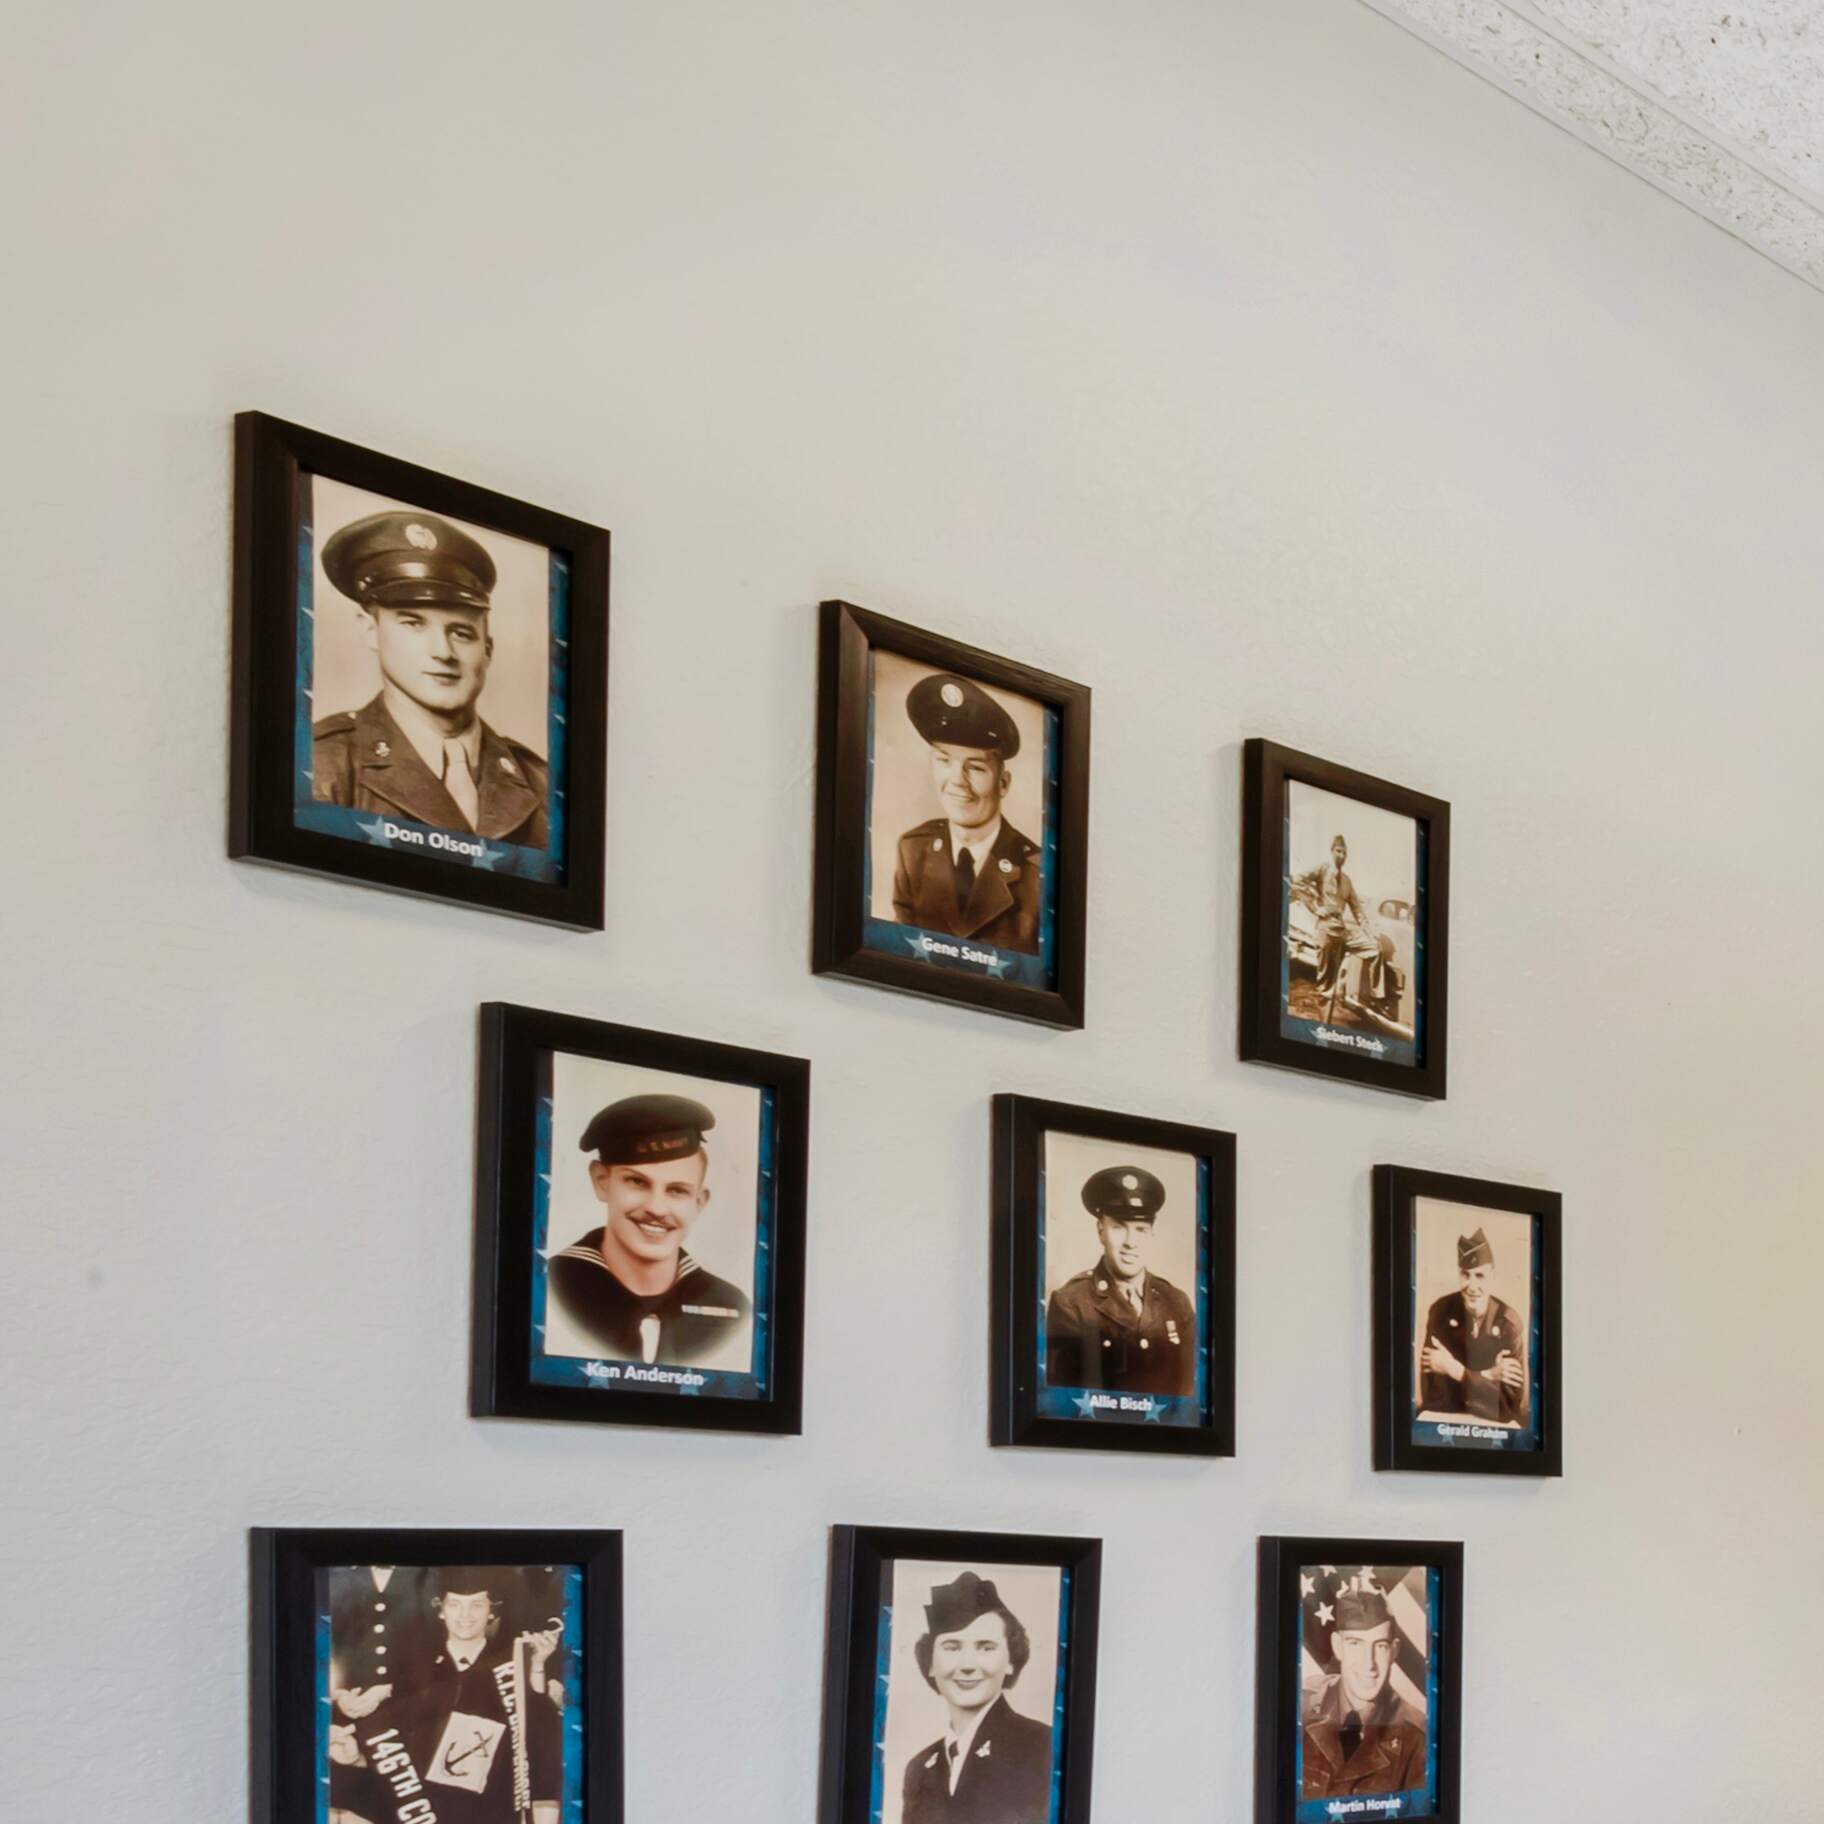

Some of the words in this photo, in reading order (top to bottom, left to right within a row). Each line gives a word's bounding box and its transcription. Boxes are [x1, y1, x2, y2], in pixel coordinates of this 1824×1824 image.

[384, 823, 423, 844] Don
[428, 833, 483, 856] Olson
[922, 938, 959, 958] Gene
[961, 946, 997, 966] Satre
[587, 1362, 620, 1378] Ken
[624, 1366, 704, 1386] Anderson
[1089, 1394, 1118, 1409] Allie
[1120, 1397, 1152, 1411] Bisch
[1437, 1424, 1470, 1437] Gerald
[366, 1728, 422, 1798] 146TH
[1328, 1800, 1365, 1813] Martin
